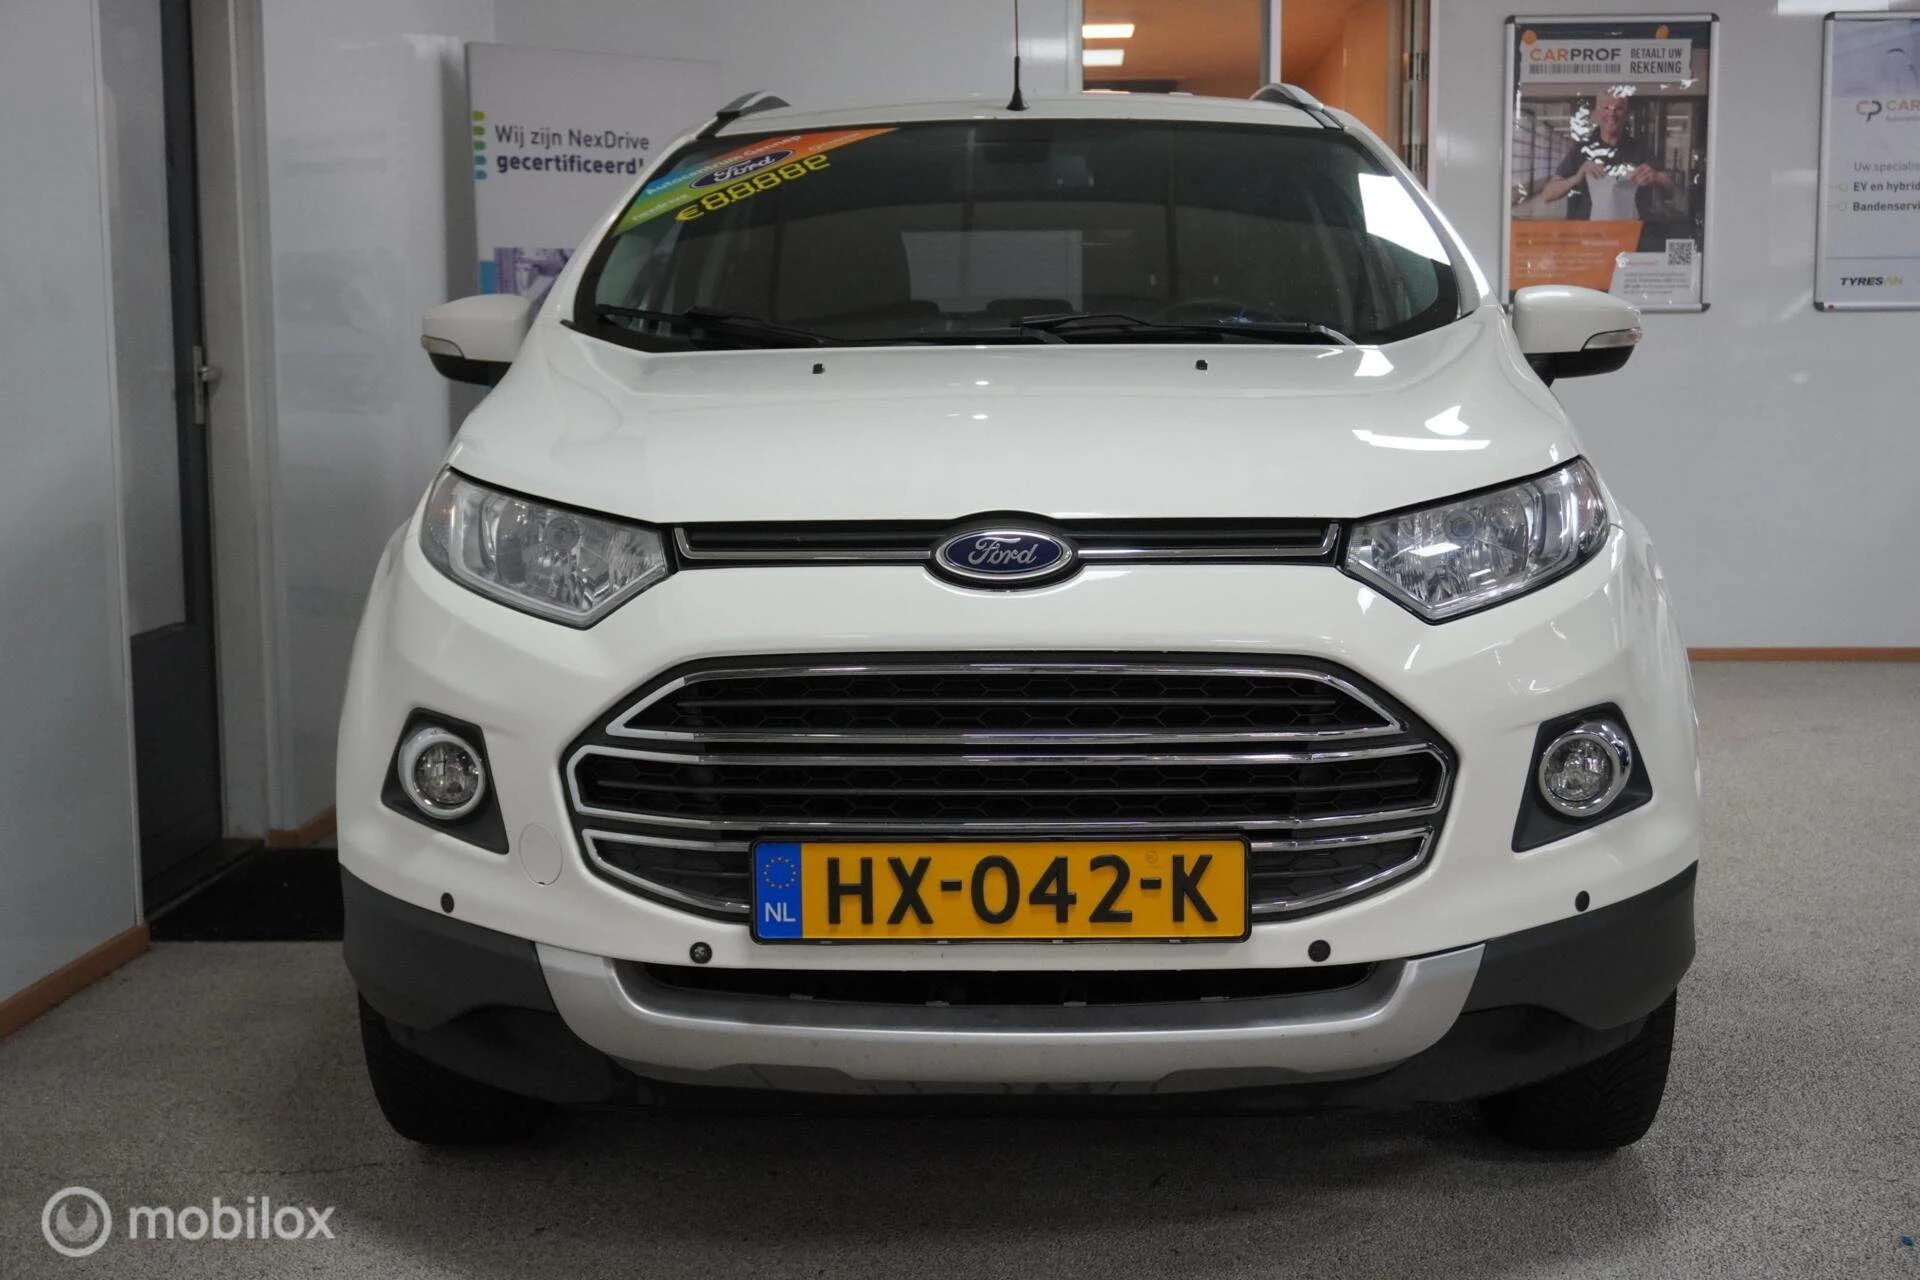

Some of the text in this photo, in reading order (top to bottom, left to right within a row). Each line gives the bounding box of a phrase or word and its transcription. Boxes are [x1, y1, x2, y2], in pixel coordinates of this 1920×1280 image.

[1529, 47, 1683, 62] CARPROF BETAALT UW
[1630, 61, 1682, 74] REKENING
[495, 124, 650, 150] Wij zijn NexDrive
[646, 155, 744, 195] Autocentrum
[714, 155, 776, 182] Ford
[1854, 162, 1871, 172] Uw
[1853, 182, 1867, 192] EV
[967, 536, 1039, 566] Ford
[826, 854, 1218, 925] HX-042-K
[765, 902, 796, 923] NL
